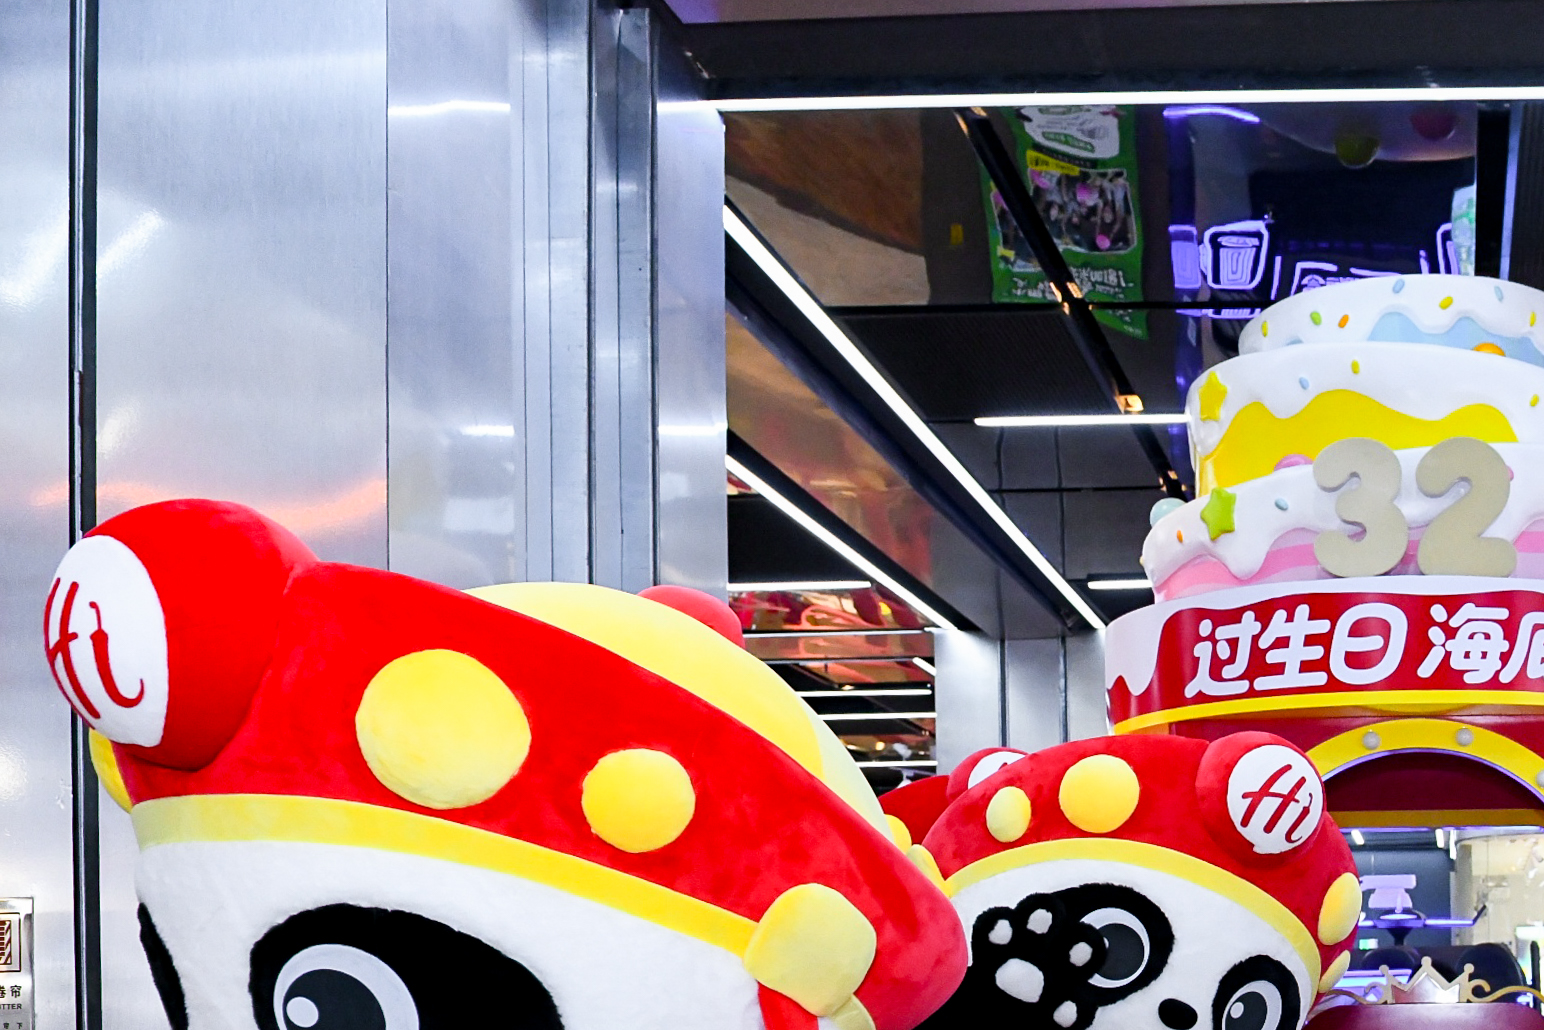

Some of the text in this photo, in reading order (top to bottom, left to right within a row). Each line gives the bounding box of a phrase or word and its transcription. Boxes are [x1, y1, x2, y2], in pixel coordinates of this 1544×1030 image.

[1313, 436, 1518, 578] 32
[43, 576, 145, 730] Hi
[1184, 602, 1409, 698] 过生日
[1240, 763, 1313, 844] Hi
